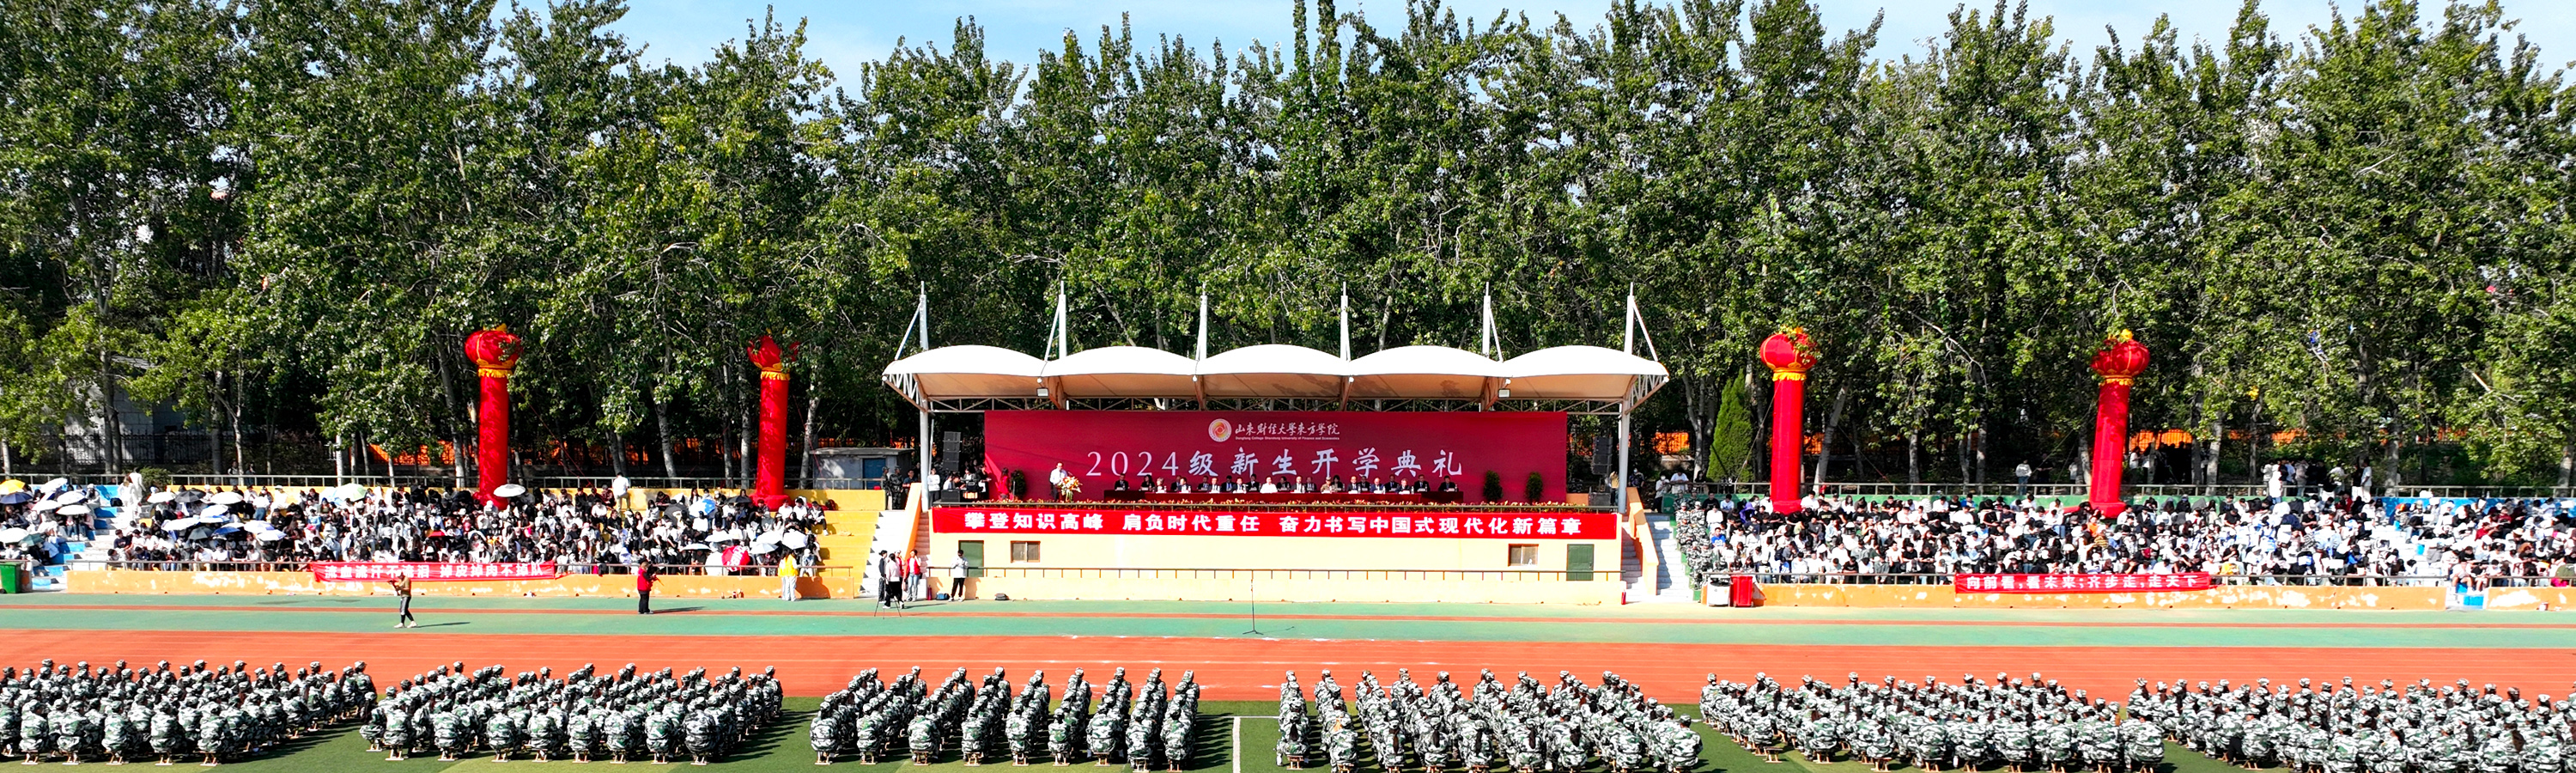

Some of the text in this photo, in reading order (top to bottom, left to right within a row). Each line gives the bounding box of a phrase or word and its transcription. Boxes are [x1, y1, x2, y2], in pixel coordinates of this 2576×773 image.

[964, 512, 1582, 535] 攀登知识高峰 肩负时代重任 奋力书写中国式现代化新篇章
[440, 561, 544, 578] 掉皮掉肉不掉队
